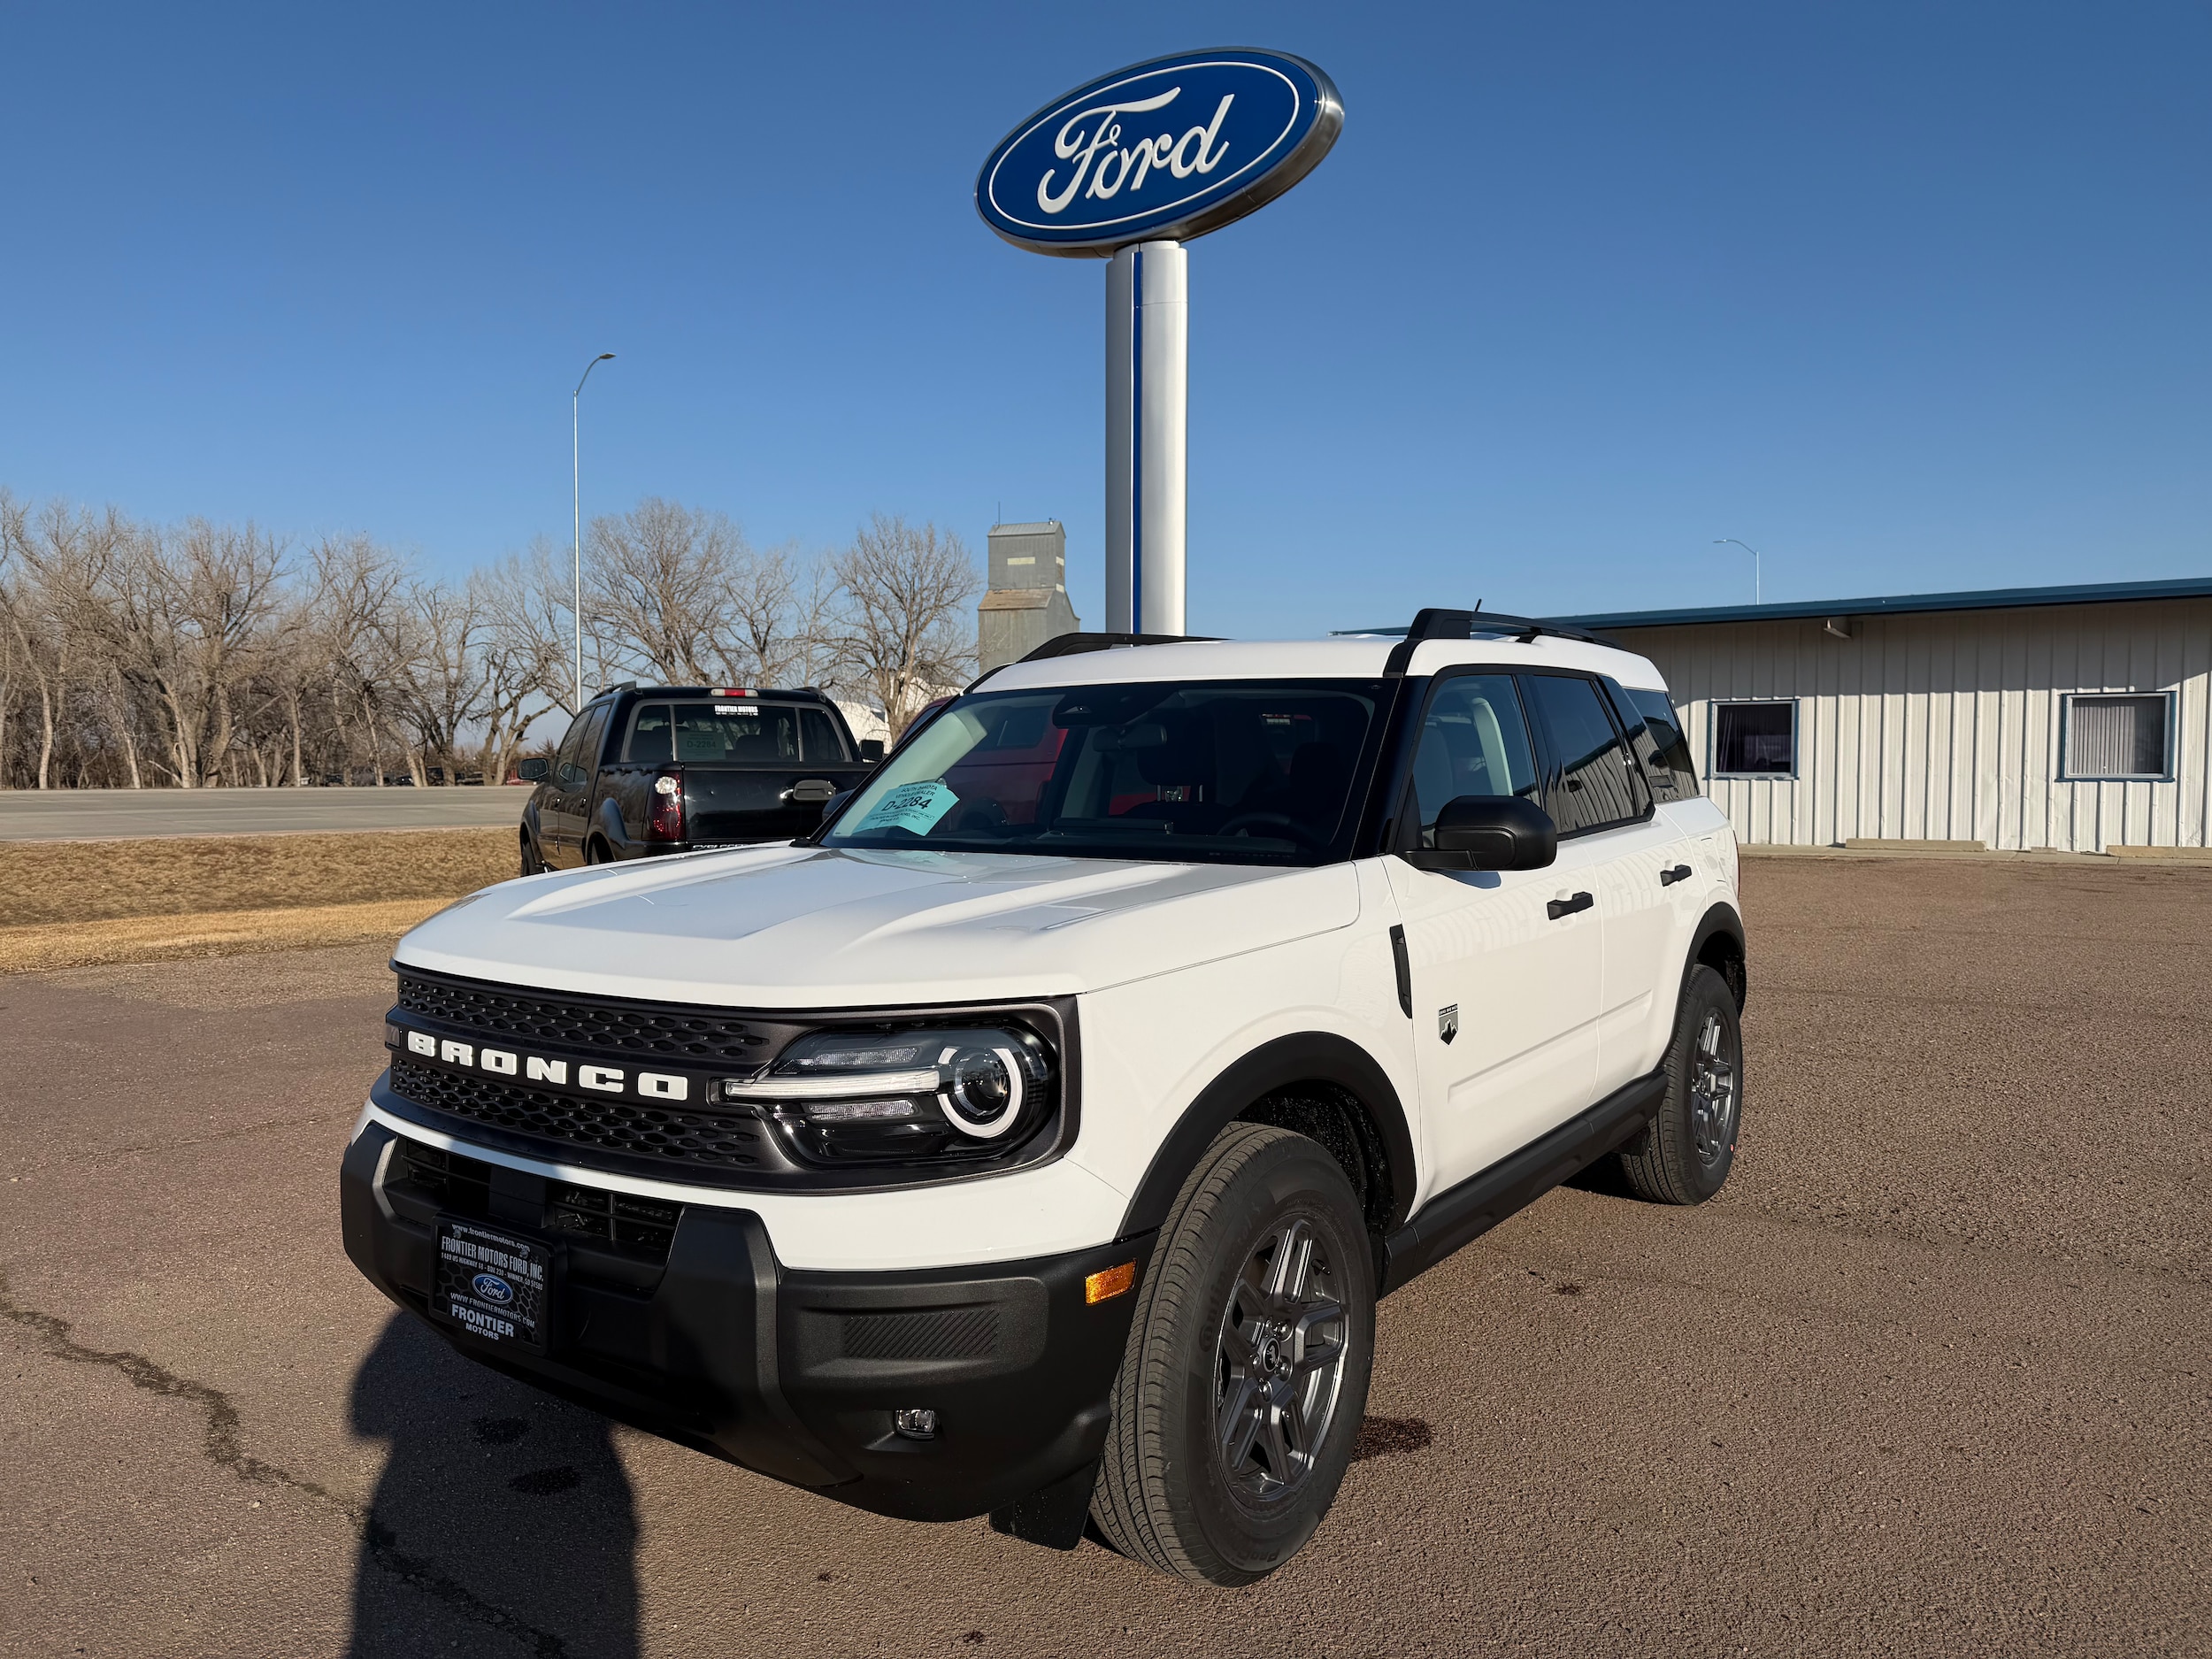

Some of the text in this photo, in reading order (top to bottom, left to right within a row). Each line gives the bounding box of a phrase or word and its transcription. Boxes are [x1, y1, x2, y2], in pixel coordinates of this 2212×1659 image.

[1037, 86, 1235, 214] Ford
[881, 796, 933, 811] D-2284
[407, 1030, 688, 1101] BRONCO
[442, 1236, 544, 1282] FRONTIER MOTORS FORD, INC.
[458, 1256, 478, 1268] HIGHWAY
[487, 1265, 495, 1274] BOX
[495, 1268, 504, 1277] 230
[480, 1278, 506, 1300] Ford
[451, 1303, 514, 1337] FRONTIER
[465, 1323, 499, 1340] MOTORS
